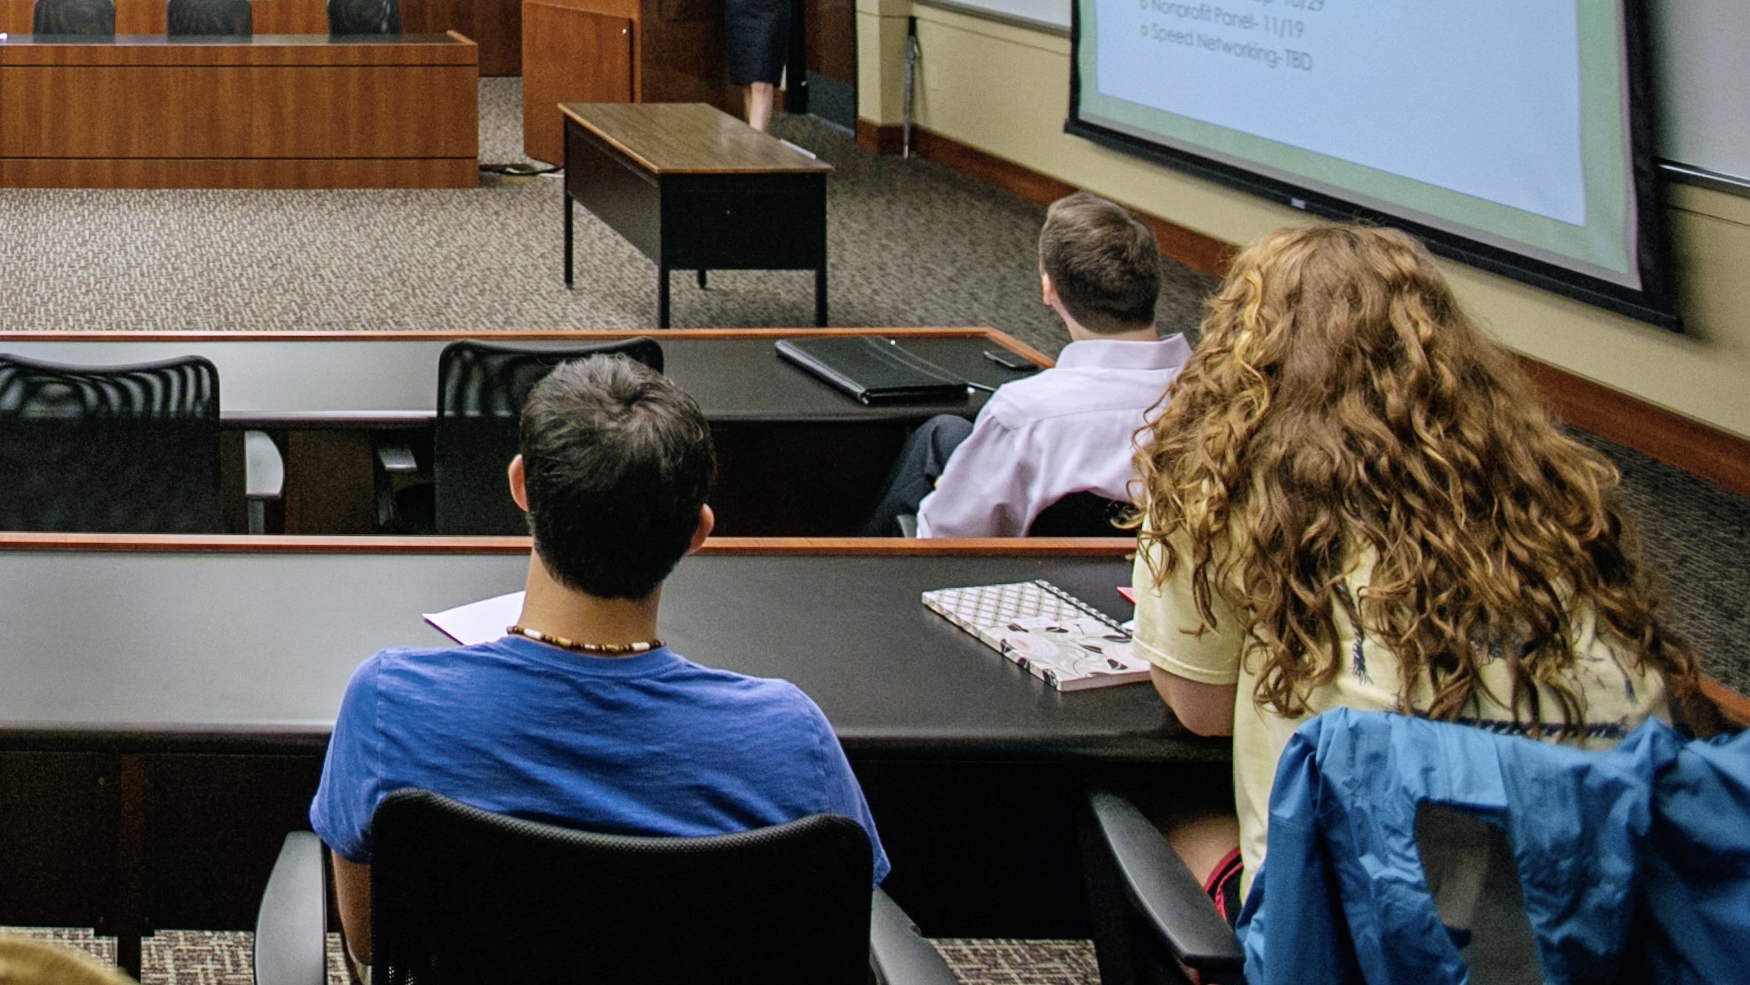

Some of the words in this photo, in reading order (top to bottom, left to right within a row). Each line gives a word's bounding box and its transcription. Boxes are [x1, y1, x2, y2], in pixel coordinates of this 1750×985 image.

[1215, 7, 1260, 30] Panel-
[1264, 16, 1305, 38] 11/19
[1152, 23, 1194, 47] Speed
[1197, 33, 1282, 68] Networking-
[1285, 49, 1313, 72] TBD
